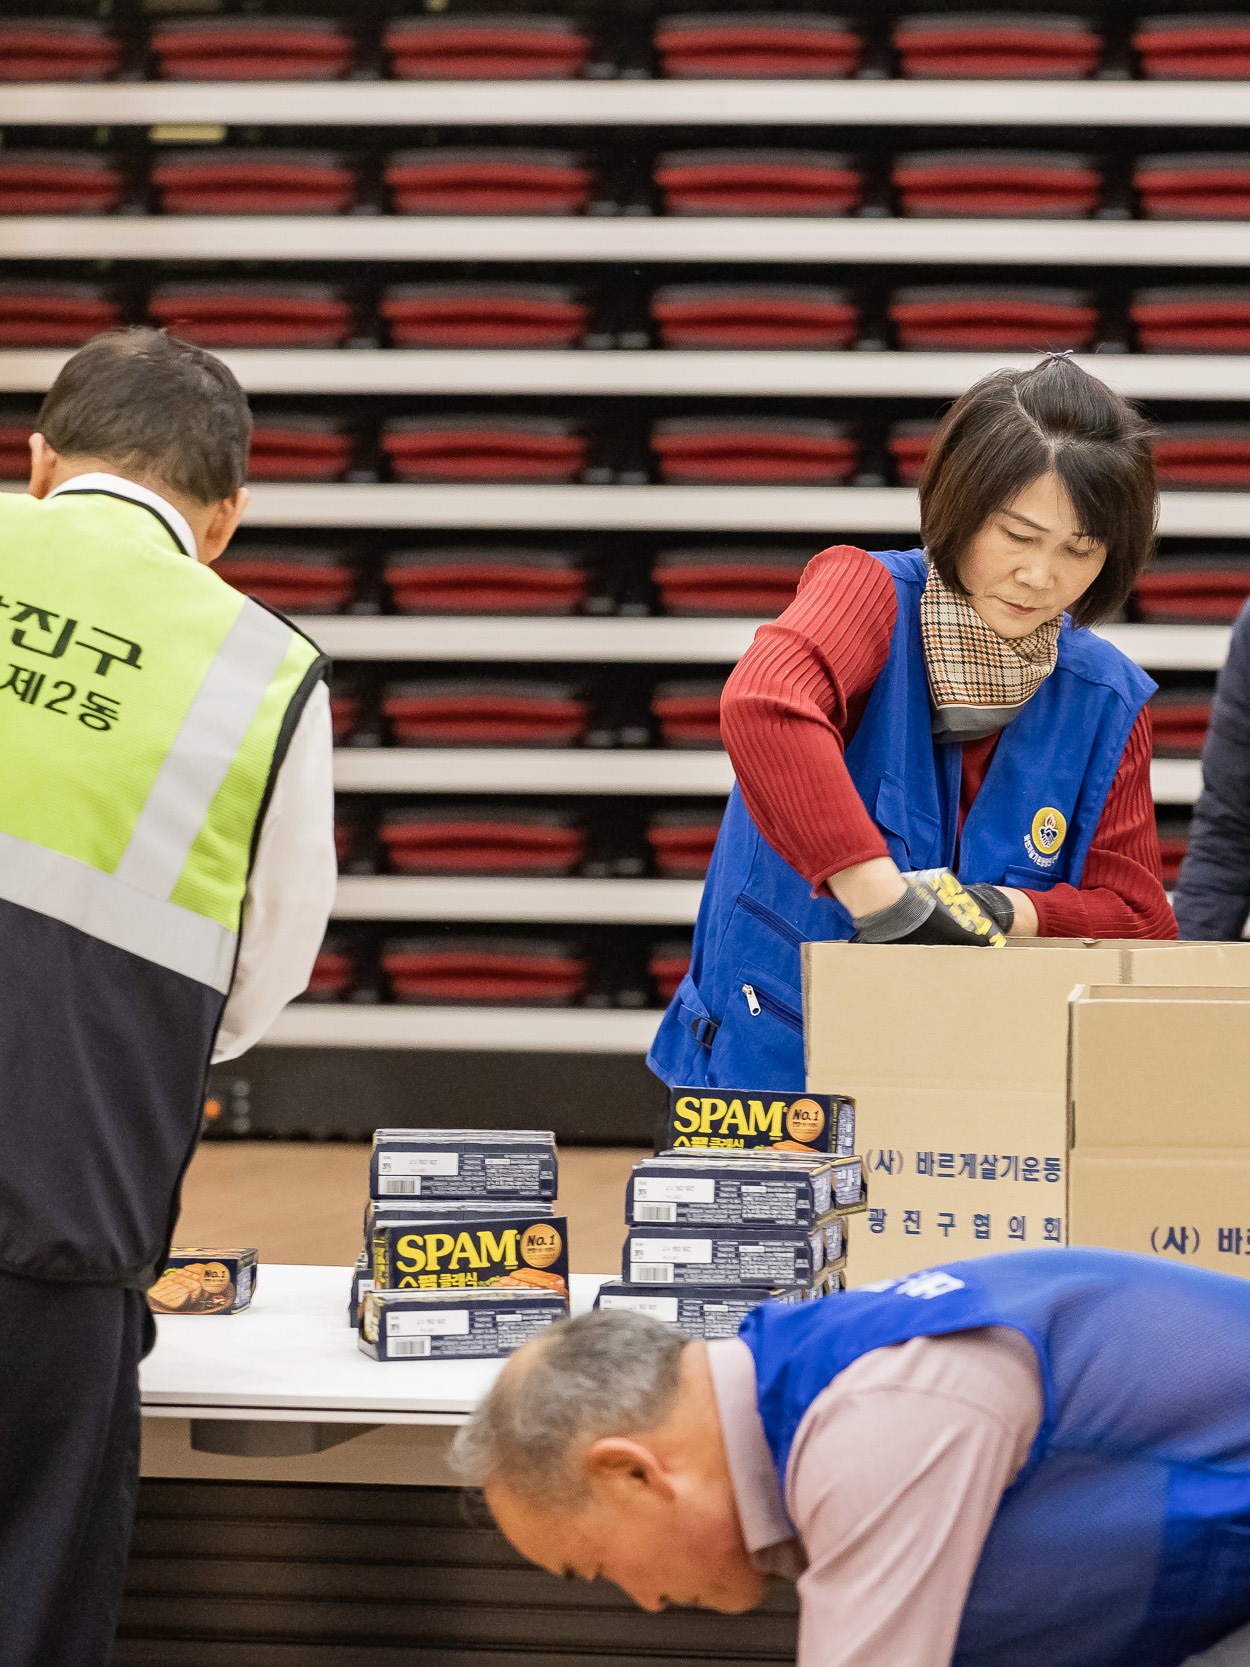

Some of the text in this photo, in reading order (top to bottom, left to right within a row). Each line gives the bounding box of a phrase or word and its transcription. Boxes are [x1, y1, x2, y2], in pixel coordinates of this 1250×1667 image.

[0, 595, 142, 677] 진구
[673, 1096, 786, 1137] SPAM
[865, 1149, 1062, 1183] (사) 바르게살기운동
[396, 1229, 519, 1273] SPAM
[1150, 1226, 1200, 1255] (사)
